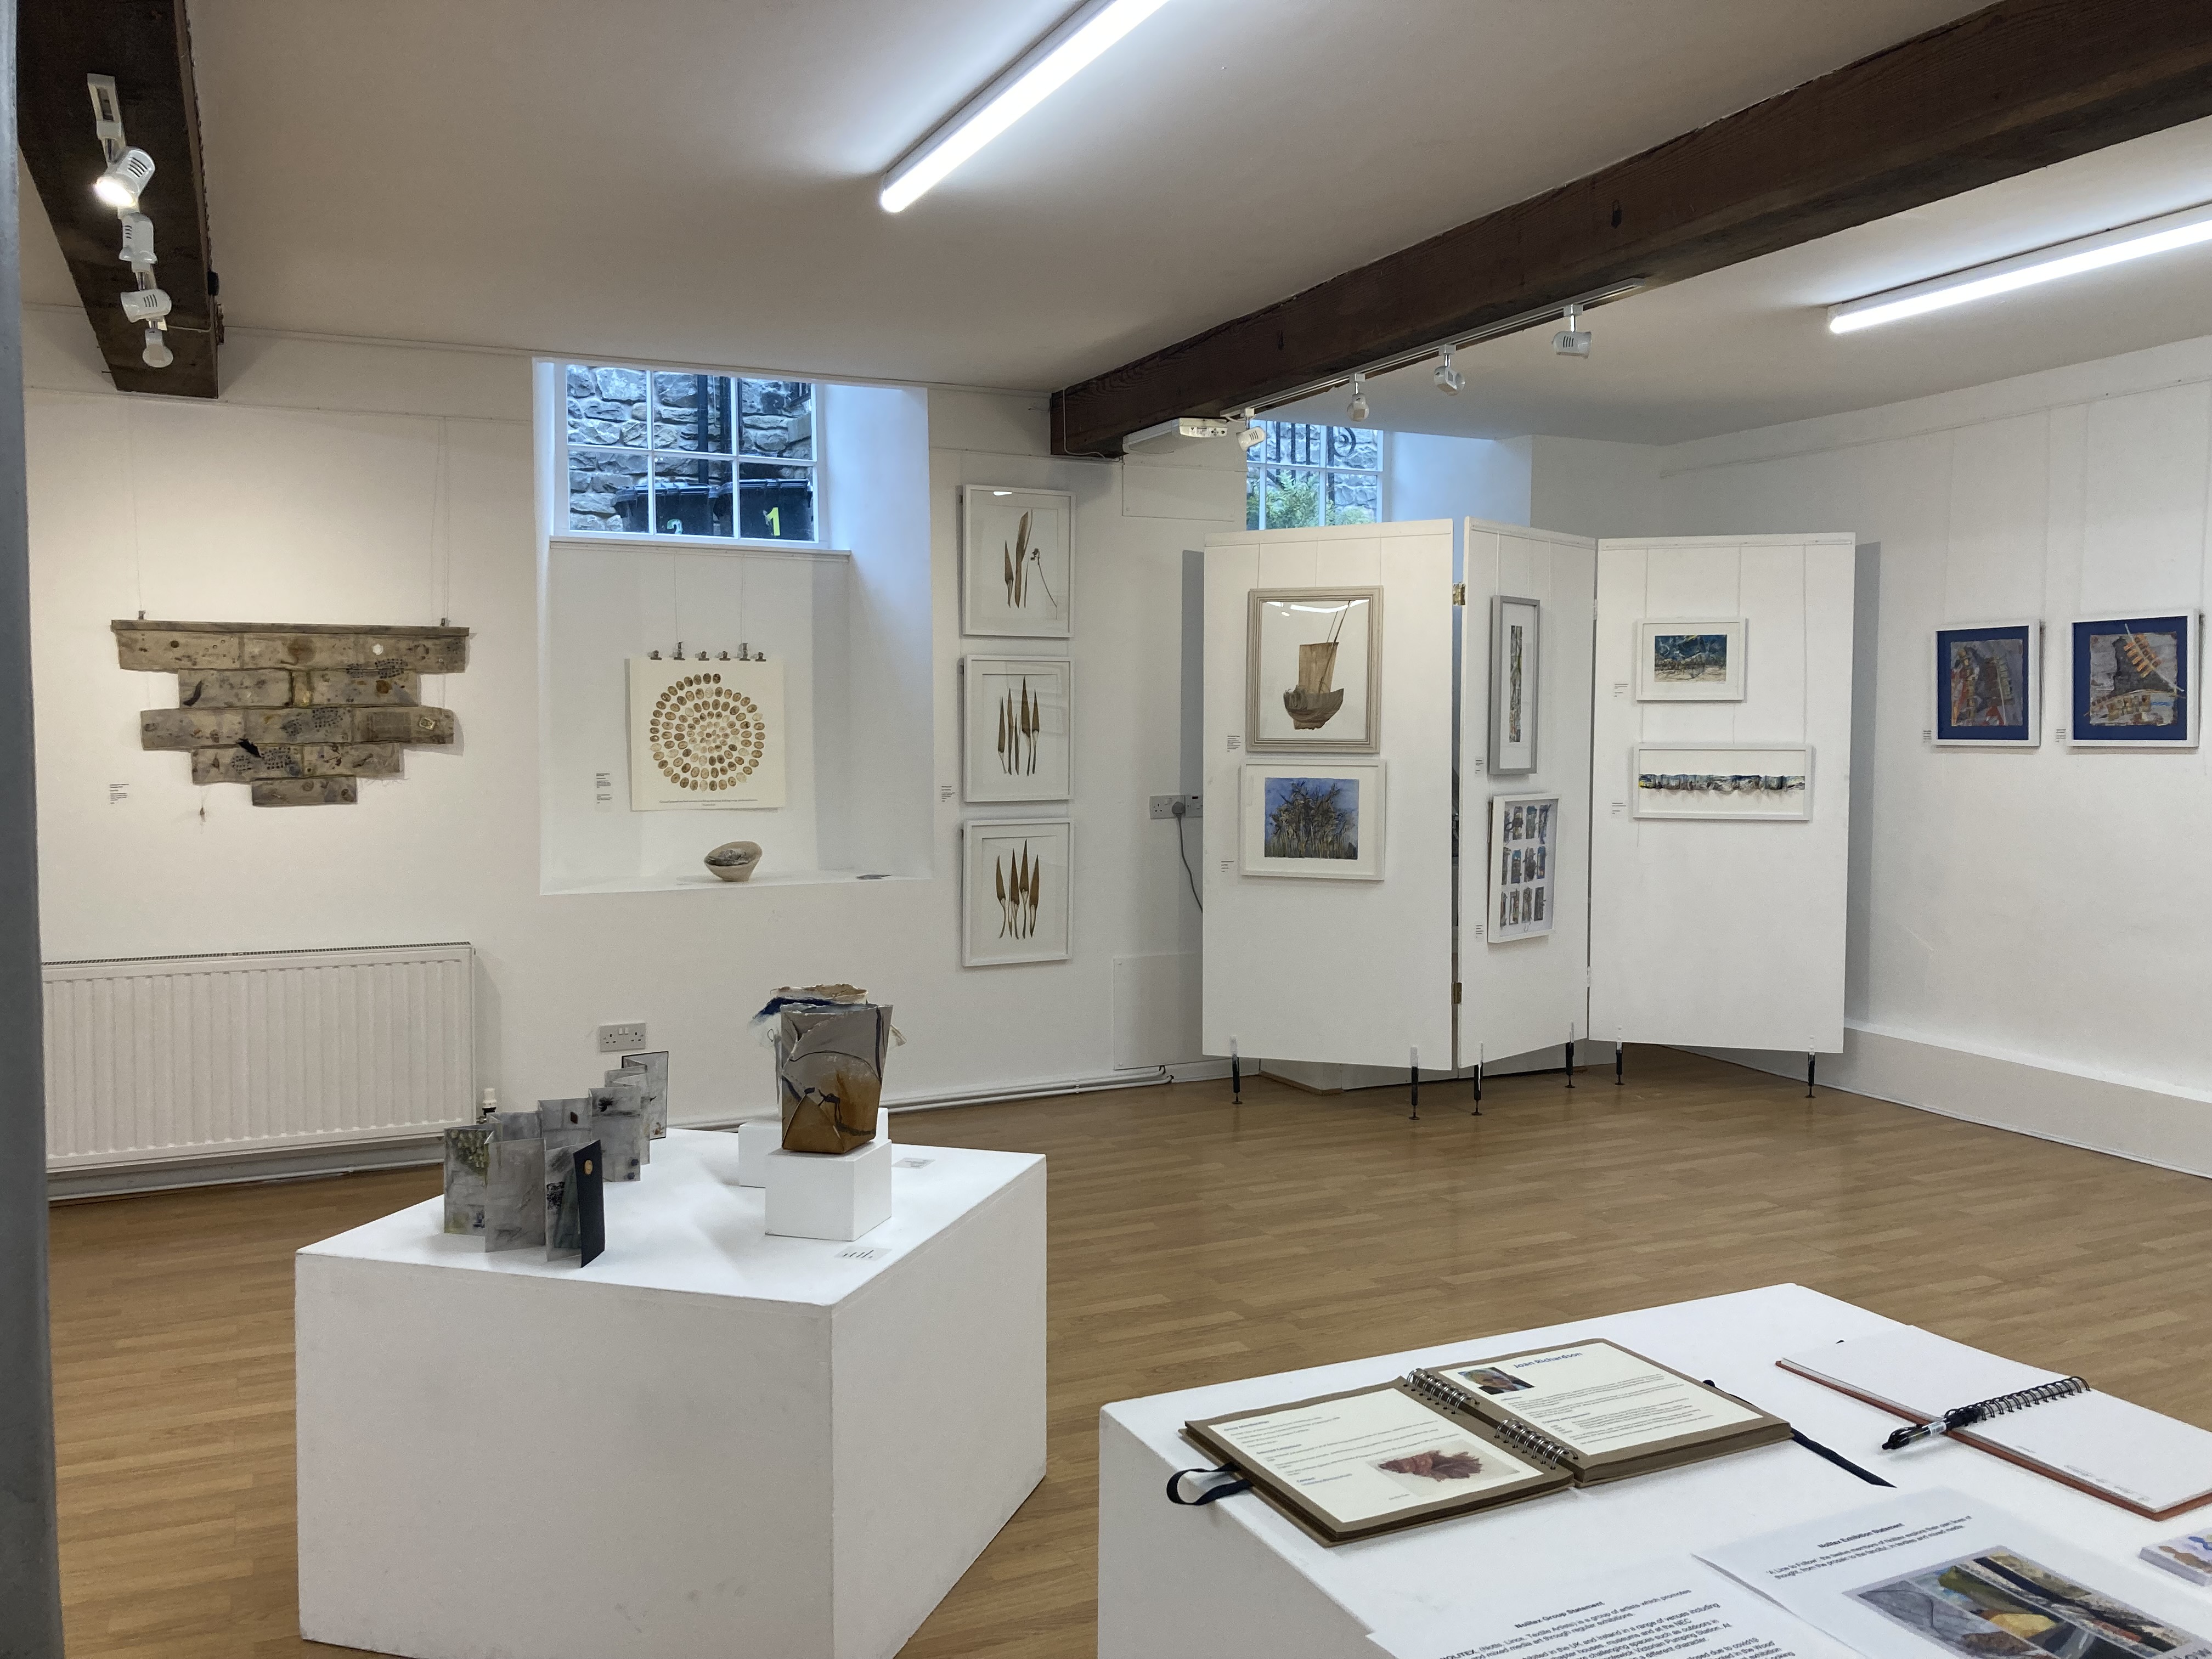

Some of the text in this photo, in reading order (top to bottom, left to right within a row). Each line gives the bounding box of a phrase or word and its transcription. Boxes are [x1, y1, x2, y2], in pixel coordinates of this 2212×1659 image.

[765, 507, 781, 536] 1
[1534, 1352, 1583, 1364] Richardson
[1542, 1612, 1567, 1621] Group
[1590, 1613, 1613, 1621] group
[1596, 1630, 1622, 1640] Ireland
[1664, 1612, 1689, 1621] venues
[1689, 1603, 1720, 1614] including
[1673, 1618, 1691, 1627] NEC
[1543, 1631, 1571, 1641] through
